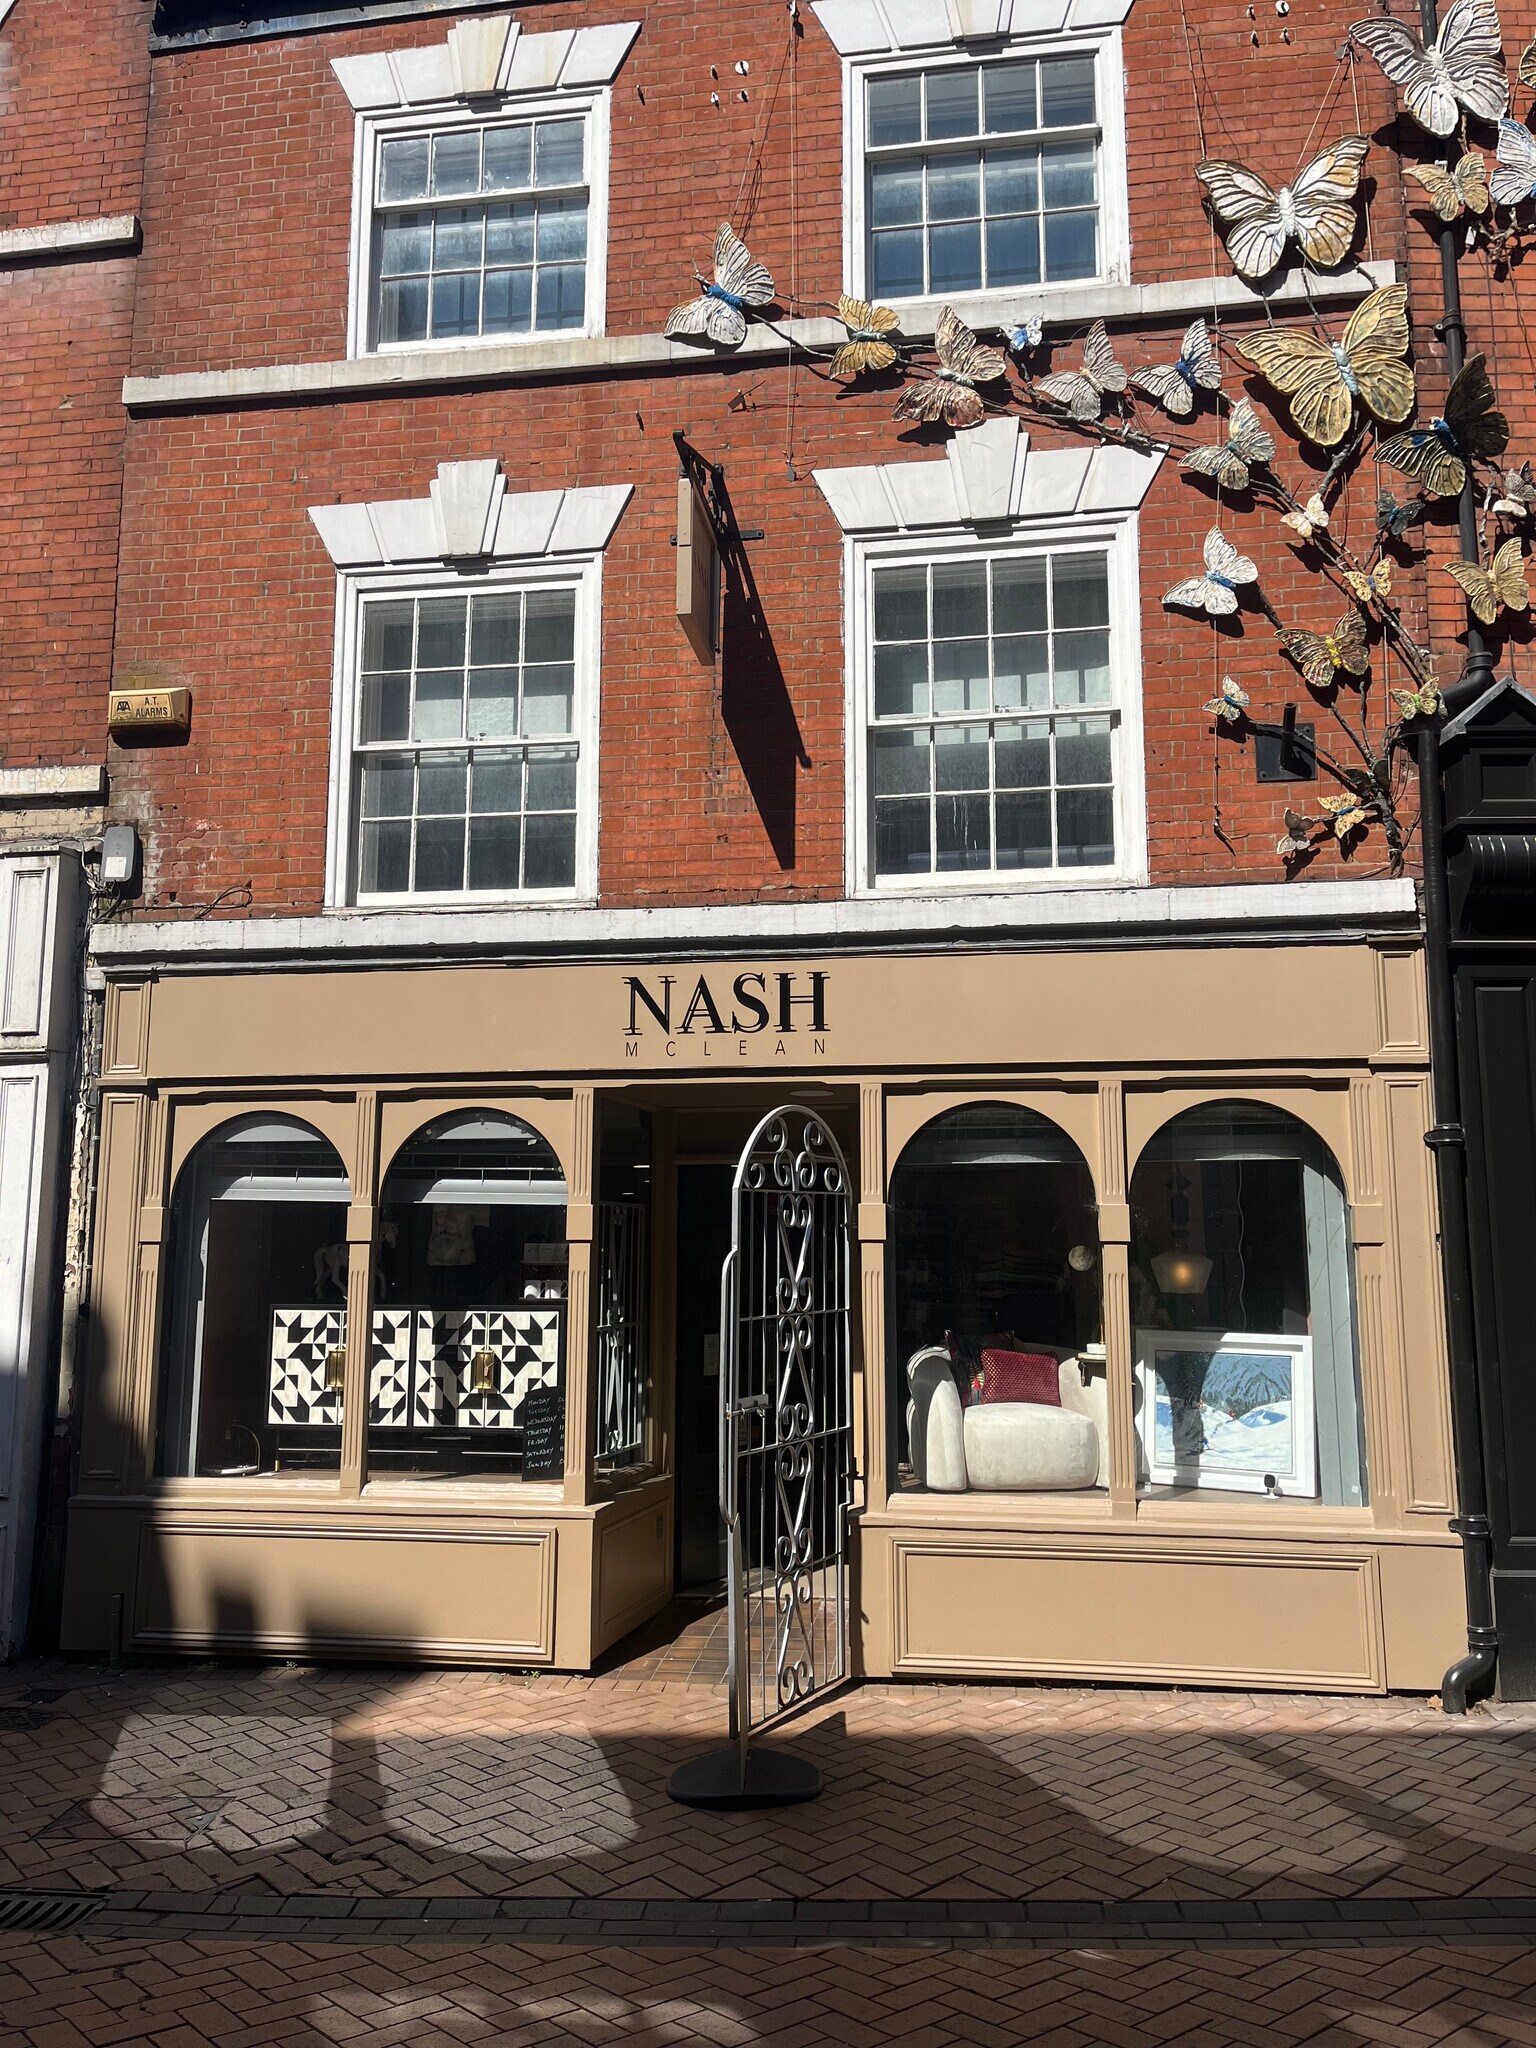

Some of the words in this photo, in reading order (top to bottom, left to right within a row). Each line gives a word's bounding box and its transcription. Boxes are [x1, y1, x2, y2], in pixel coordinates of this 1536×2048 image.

[144, 697, 159, 705] A.T.
[135, 706, 168, 718] ALARMS
[621, 971, 831, 1036] NASH
[625, 1038, 825, 1058] MCLEAN
